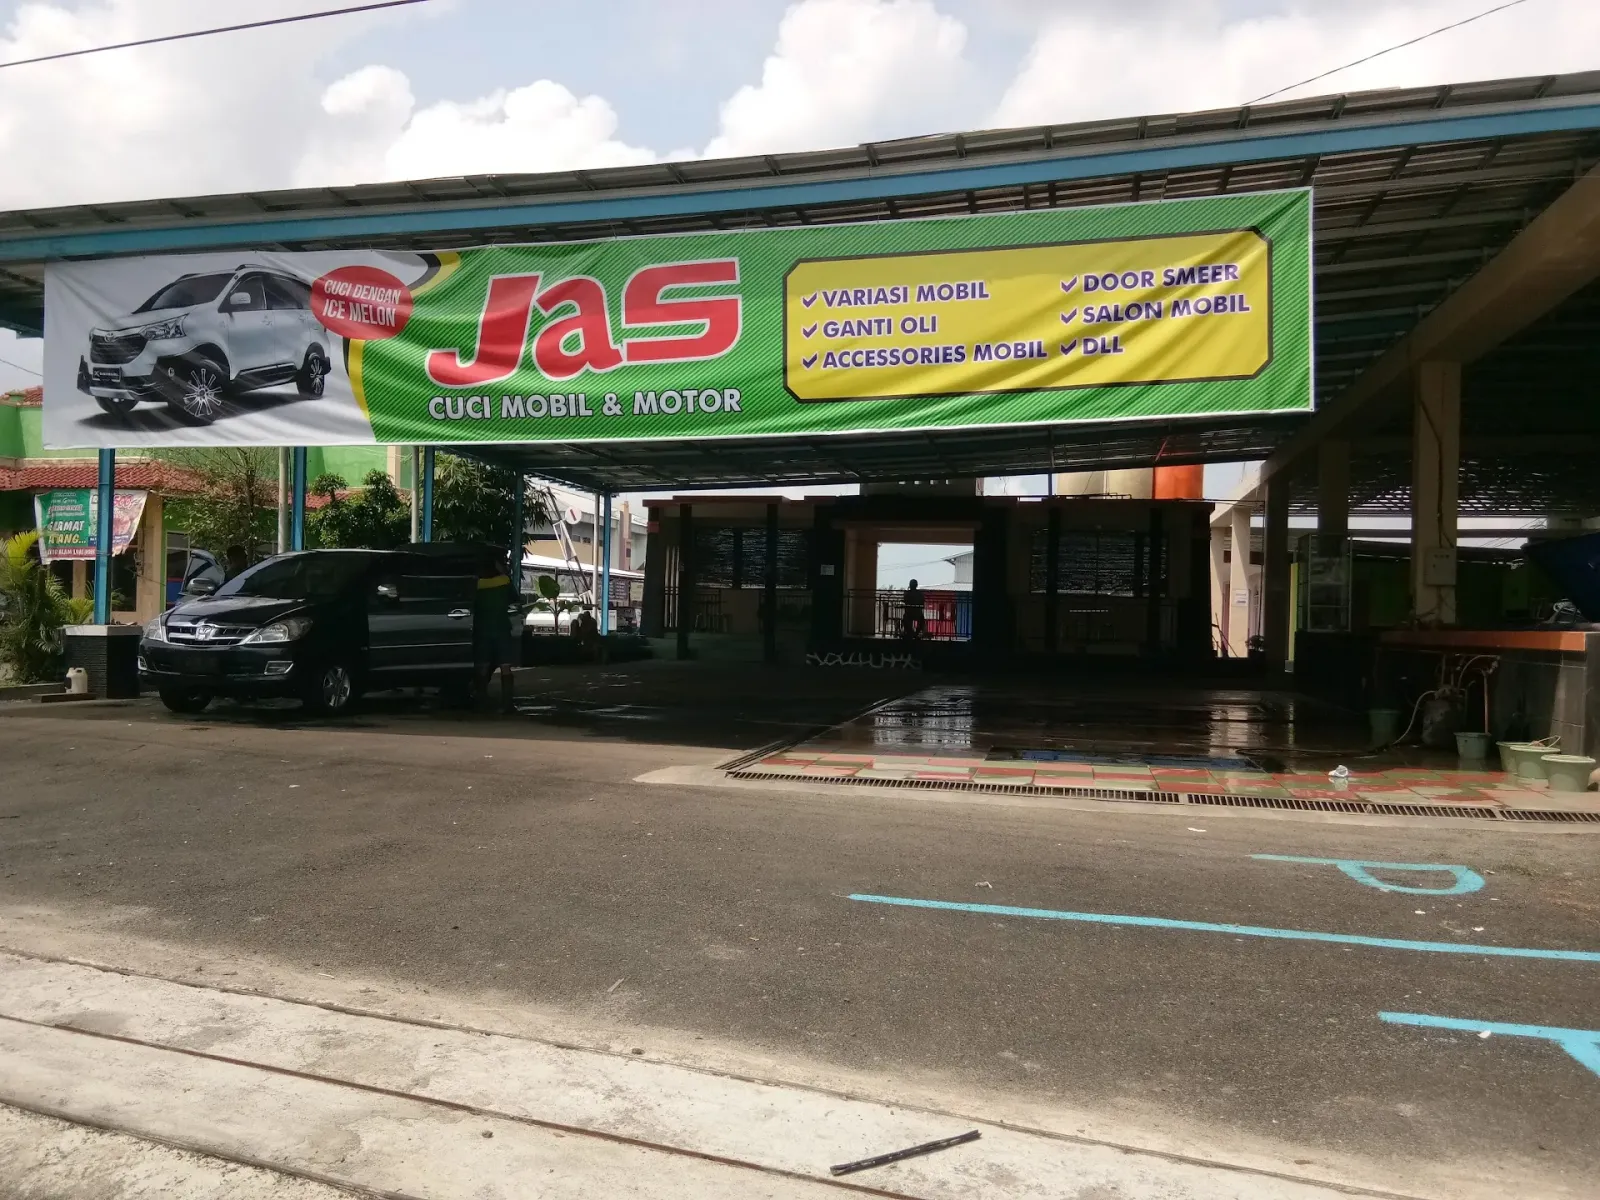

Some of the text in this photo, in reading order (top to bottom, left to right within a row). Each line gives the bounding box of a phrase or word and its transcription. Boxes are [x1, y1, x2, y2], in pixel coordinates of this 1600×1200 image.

[324, 279, 401, 305] CUCI DENGAN
[1083, 264, 1240, 293] DOOR SMEER
[822, 280, 990, 308] VARIASI MOBIL
[322, 298, 396, 327] ICE MELON
[1082, 294, 1251, 325] SALON MOBIL
[822, 315, 937, 338] GANTI OLI
[822, 340, 1048, 369] ACCESSORIES MOBIL
[1082, 335, 1125, 355] DLL
[428, 388, 743, 420] CUCI MOBIL & MOTOR
